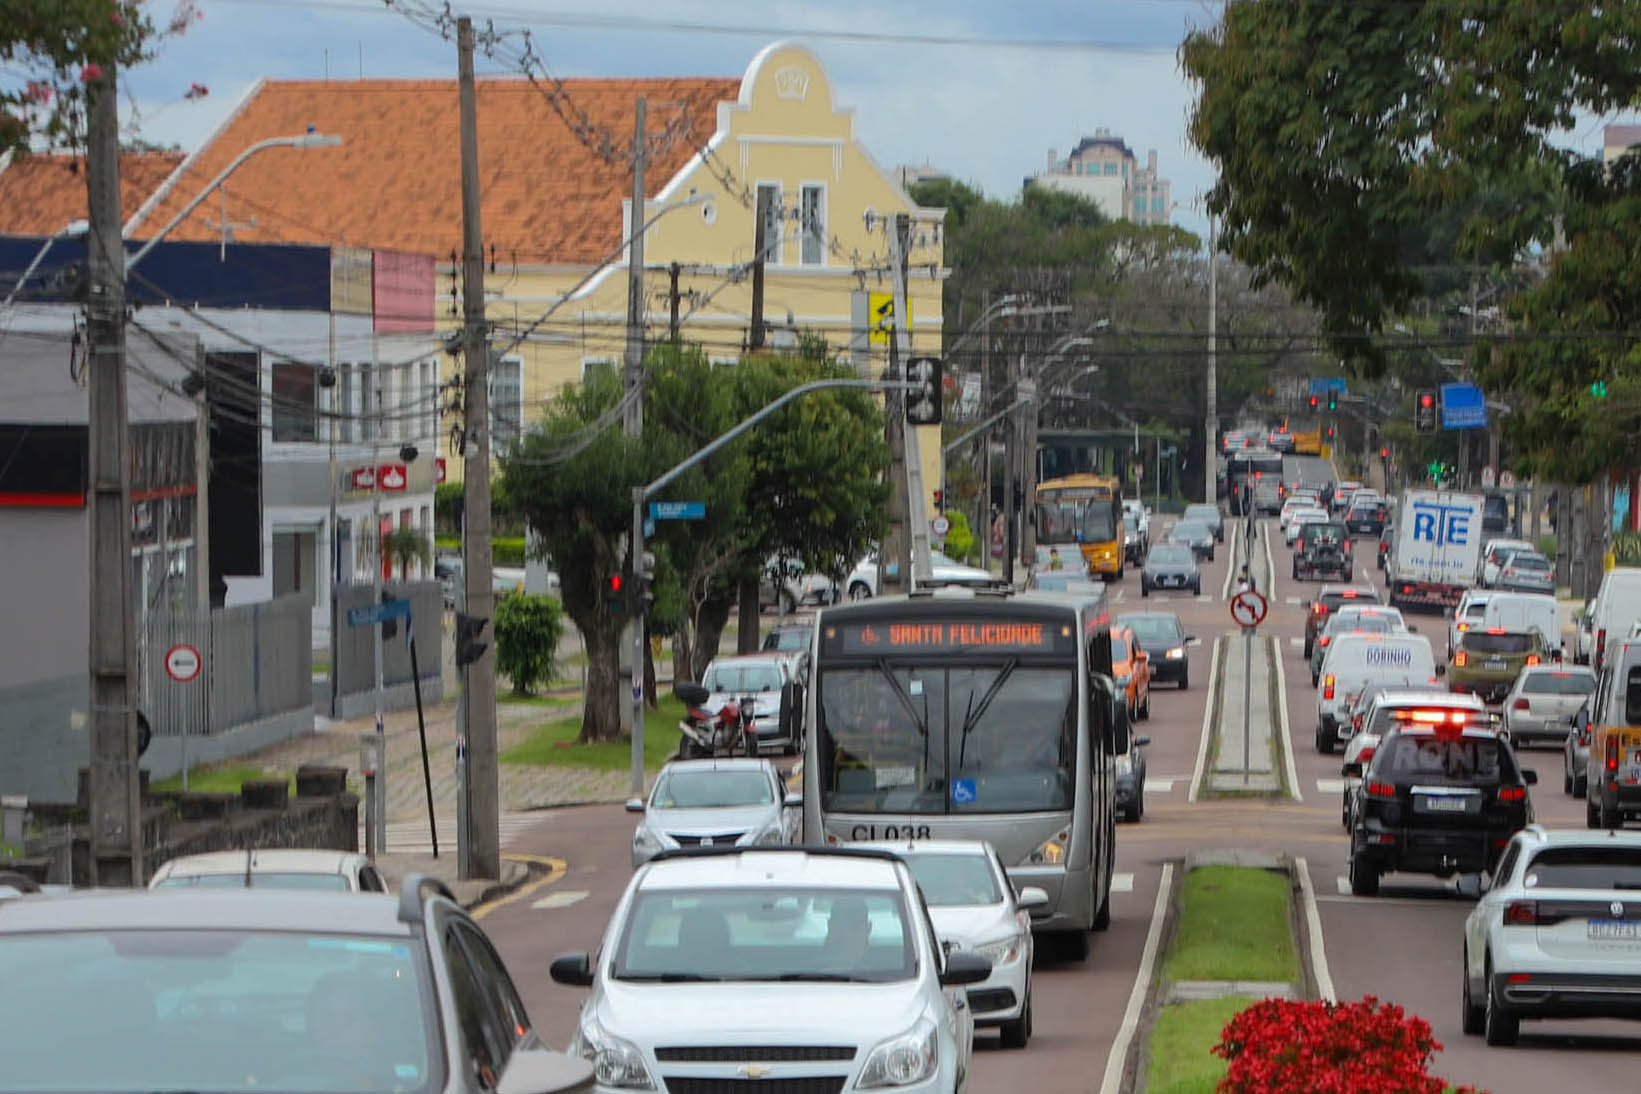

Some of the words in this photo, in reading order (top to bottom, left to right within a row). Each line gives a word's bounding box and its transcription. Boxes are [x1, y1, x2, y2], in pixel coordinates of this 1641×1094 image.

[1413, 502, 1474, 547] RTE
[889, 624, 943, 645] SANTA
[949, 624, 1043, 645] FELICIDADE
